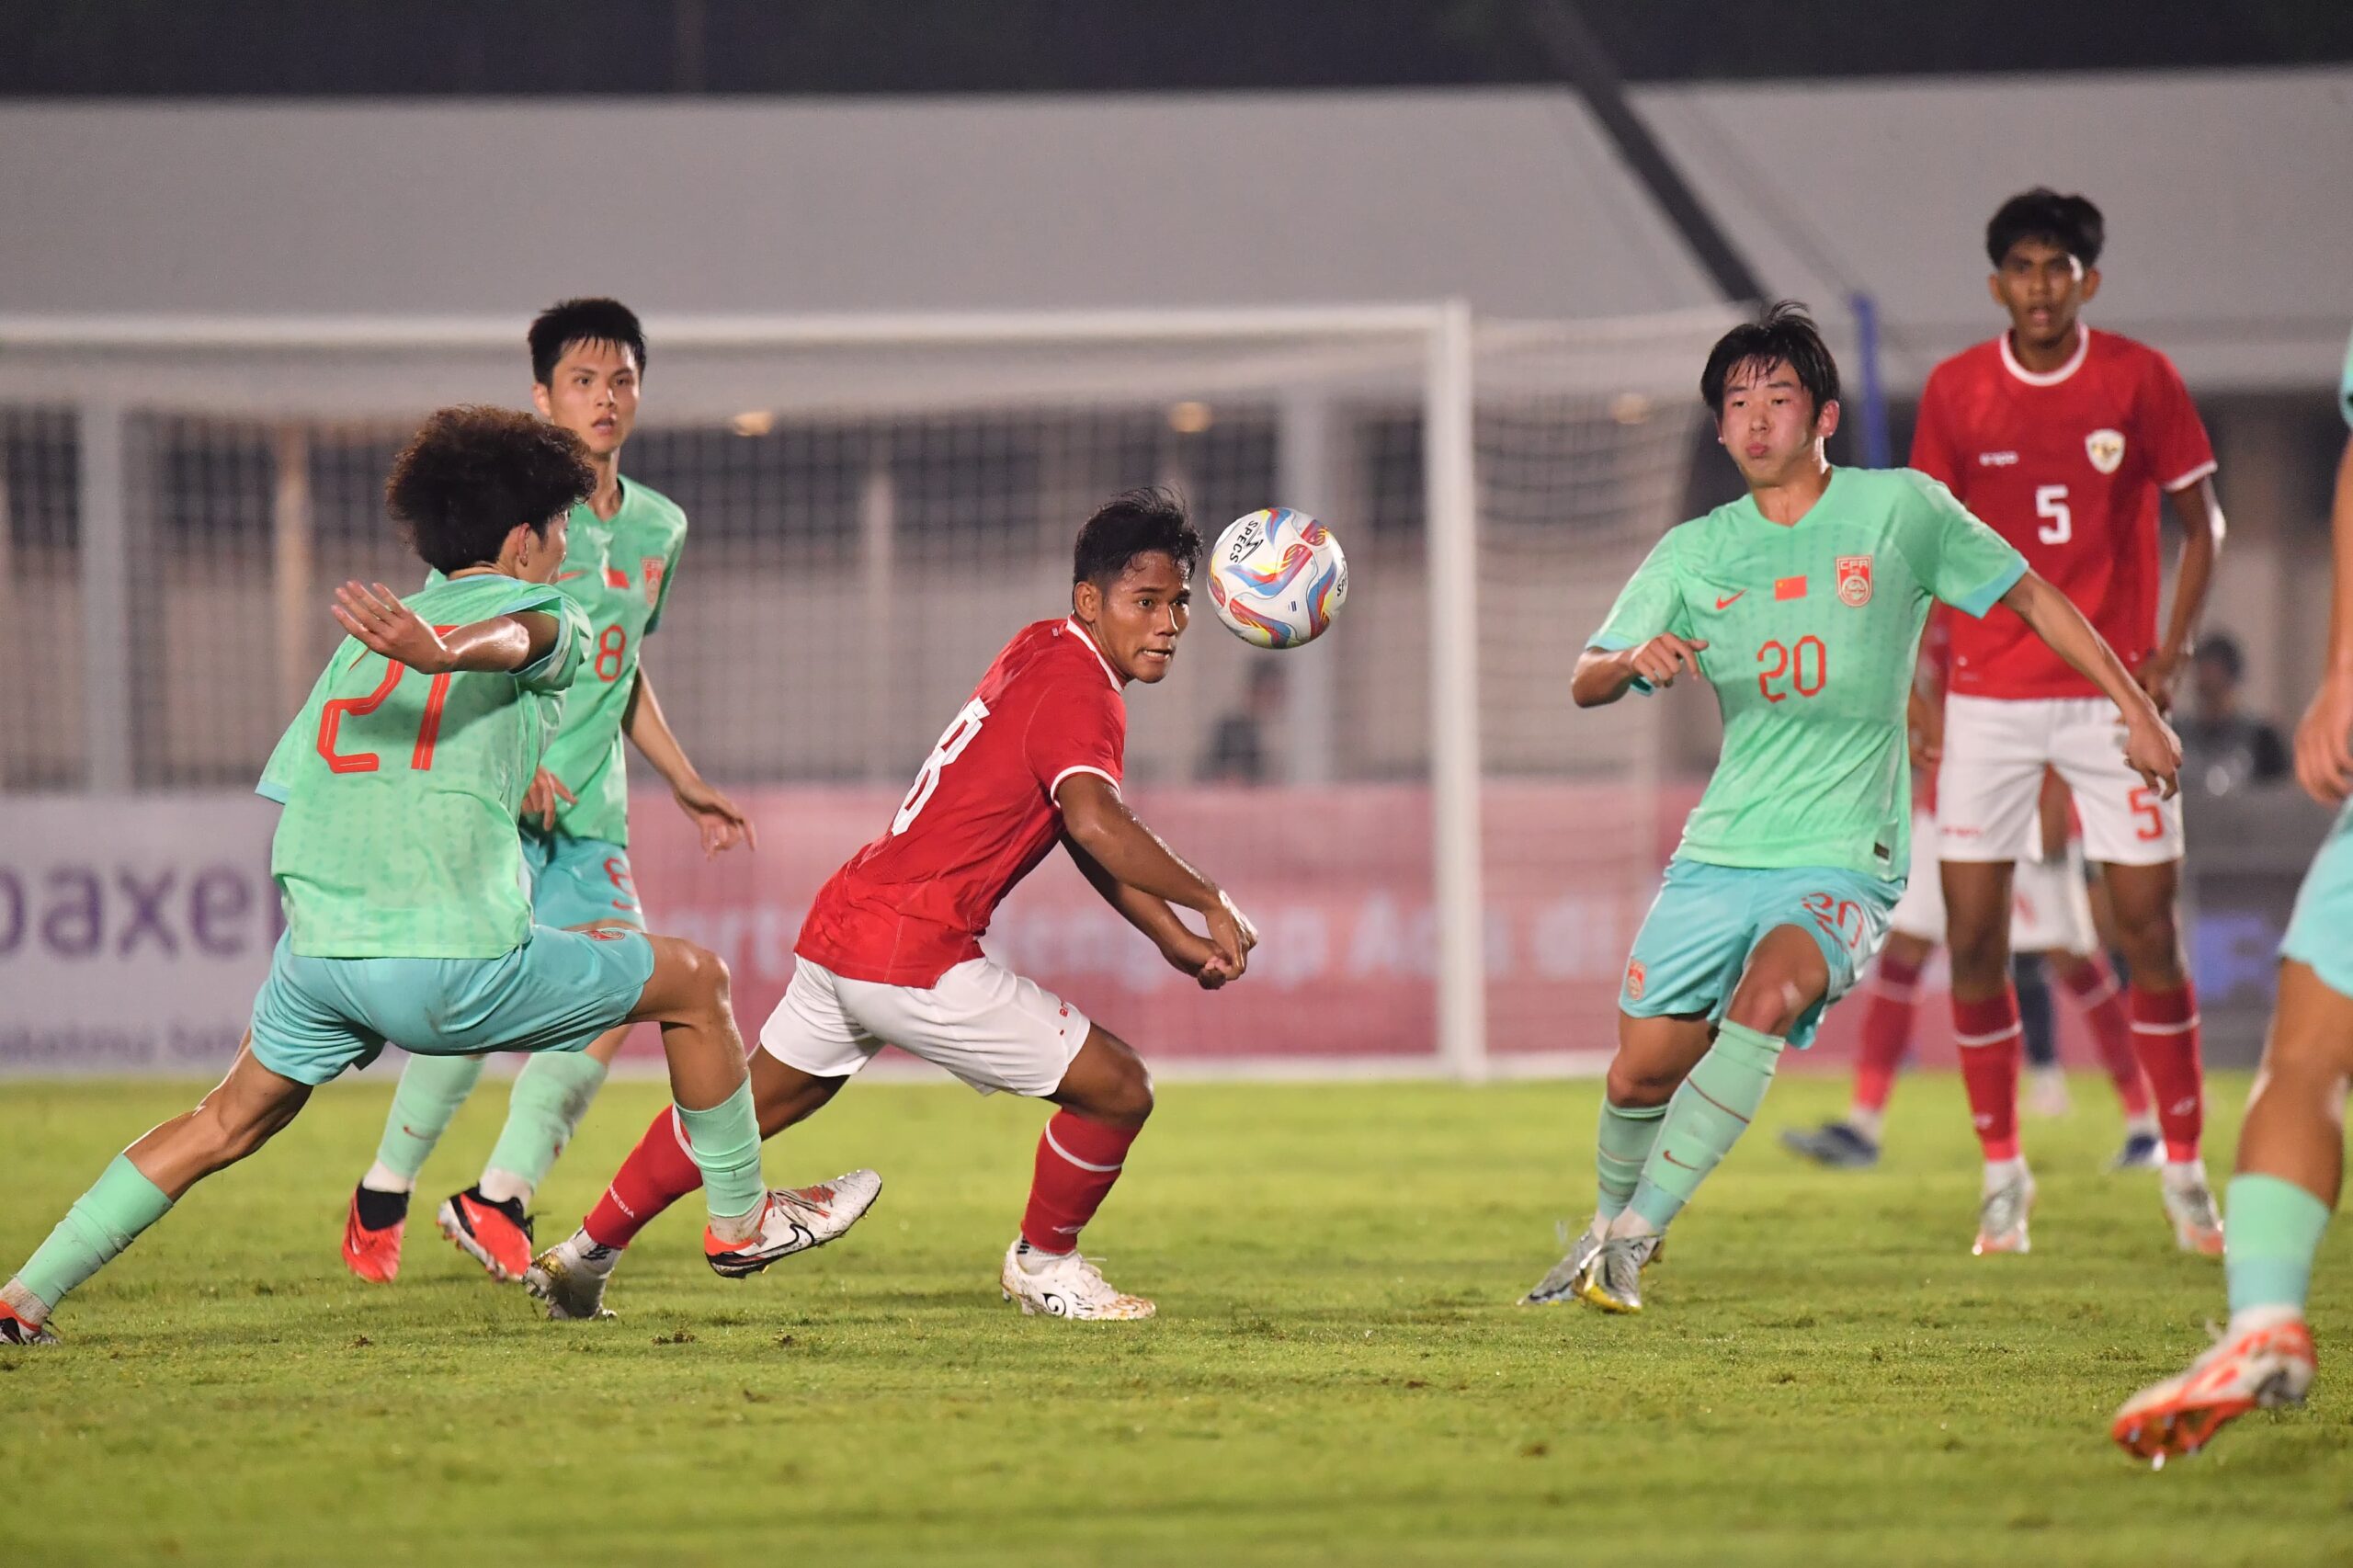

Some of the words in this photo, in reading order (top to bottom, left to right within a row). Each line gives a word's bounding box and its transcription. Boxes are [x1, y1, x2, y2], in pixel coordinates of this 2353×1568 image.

[1230, 520, 1258, 563] SPECS
[2036, 483, 2071, 545] 5
[595, 624, 627, 683] 8
[1756, 635, 1827, 704] 20
[316, 625, 460, 774] 27
[2127, 786, 2165, 841] 5
[1802, 891, 1864, 949] 20
